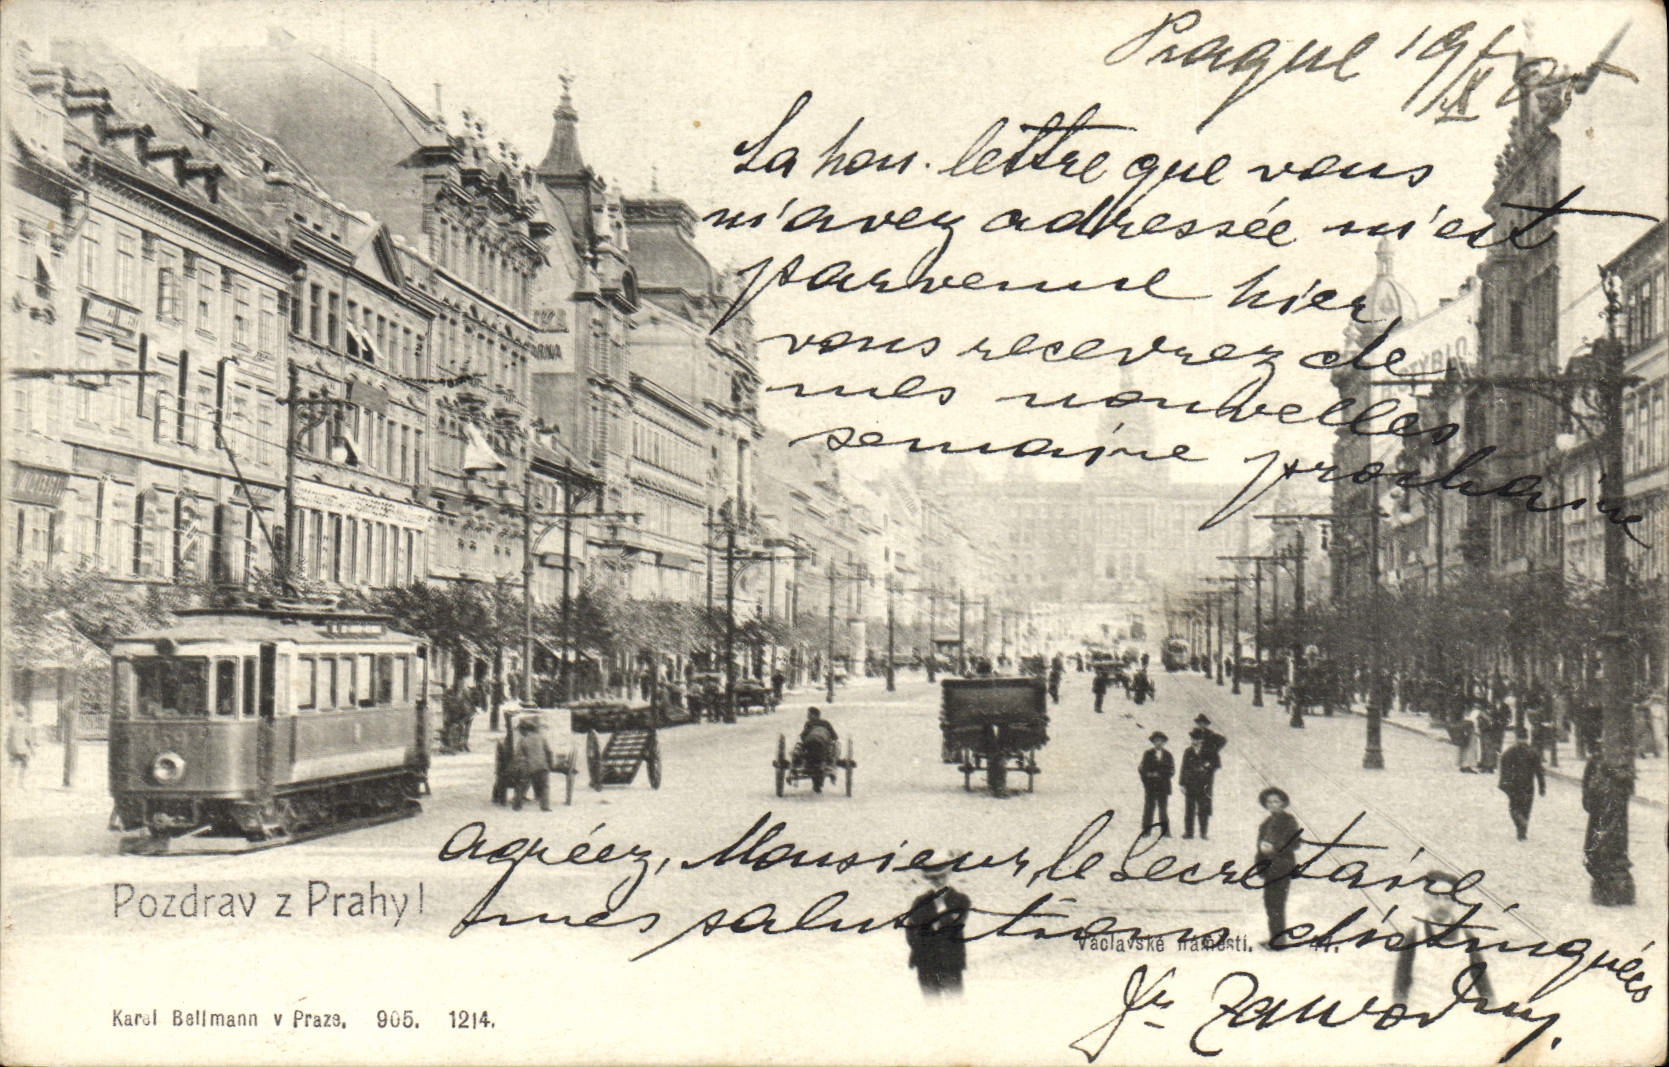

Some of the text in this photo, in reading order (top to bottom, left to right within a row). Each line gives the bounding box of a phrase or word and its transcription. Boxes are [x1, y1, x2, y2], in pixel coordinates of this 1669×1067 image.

[1104, 9, 1381, 134] Prague
[733, 90, 813, 179] La
[937, 103, 1137, 184] lettre
[1088, 153, 1233, 237] que
[1247, 154, 1434, 187] vous
[701, 186, 1660, 290] m'avez adressée m'est
[709, 253, 1213, 336] parvenue
[757, 315, 1456, 418] vous recevrez de
[766, 375, 1460, 446] mes nouvelles
[788, 422, 1652, 550] semaine prochaine
[1038, 809, 1115, 881] le
[462, 910, 661, 934] mes
[629, 890, 1230, 962] salutations
